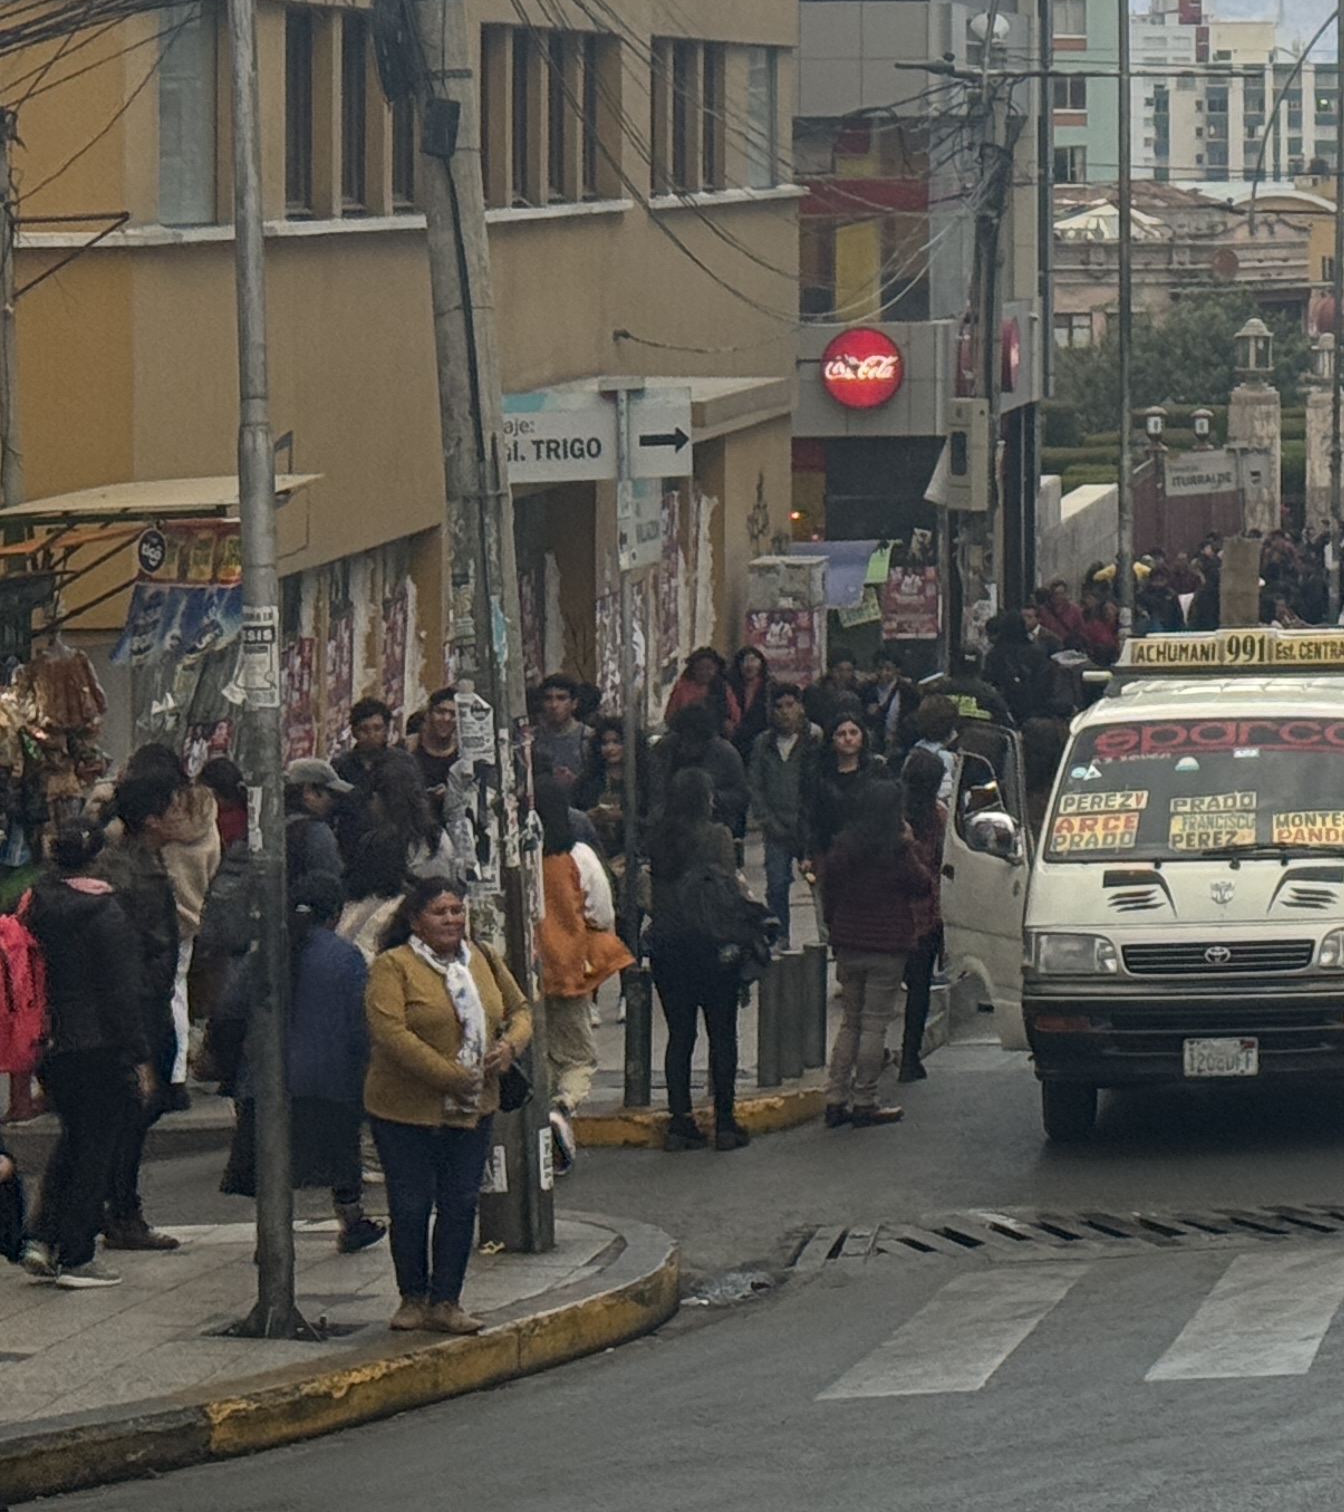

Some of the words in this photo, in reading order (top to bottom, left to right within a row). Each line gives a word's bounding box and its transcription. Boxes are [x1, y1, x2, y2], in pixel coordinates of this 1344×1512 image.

[531, 437, 602, 461] TRIGO
[1136, 642, 1216, 664] ACHUMANI
[1227, 635, 1266, 664] 991
[1063, 794, 1132, 813] PEREZ
[1173, 794, 1254, 812] PRADO
[1054, 815, 1138, 833] ARCE
[1052, 831, 1134, 850] PRADO
[1171, 831, 1238, 851] PEREZ
